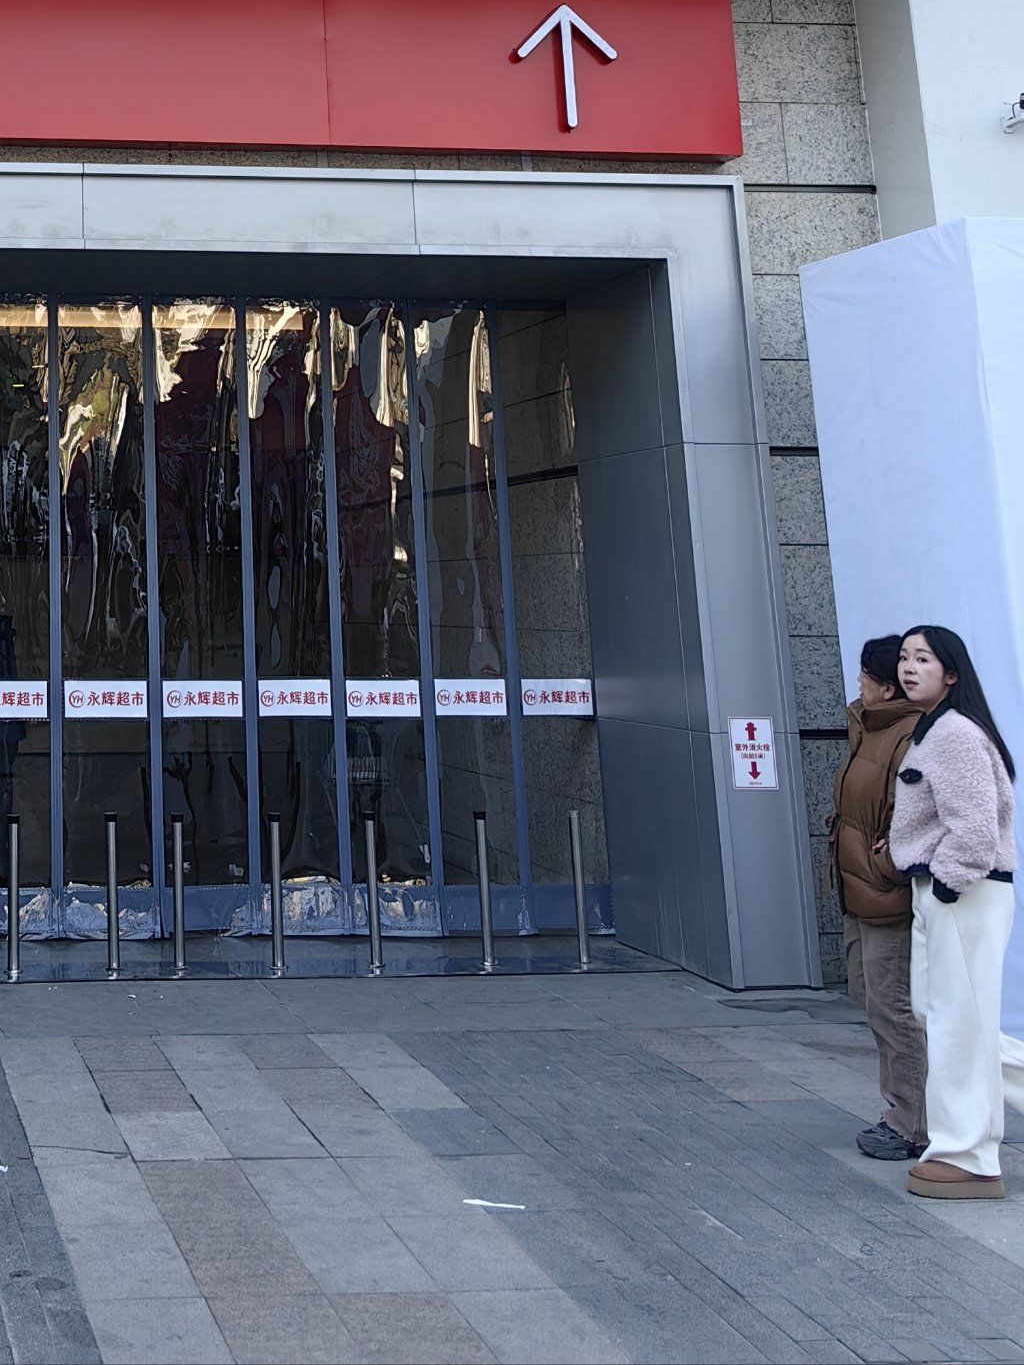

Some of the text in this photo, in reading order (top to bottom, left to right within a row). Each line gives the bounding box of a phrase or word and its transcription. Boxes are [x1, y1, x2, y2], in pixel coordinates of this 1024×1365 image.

[86, 691, 145, 707] 永辉超市
[183, 691, 240, 706] 永辉超市
[276, 690, 329, 705] 永辉超市
[365, 691, 418, 706] 永辉超市
[452, 690, 504, 705] 永辉超市
[539, 690, 590, 705] 永辉超市
[734, 743, 771, 752] 室外消火栓
